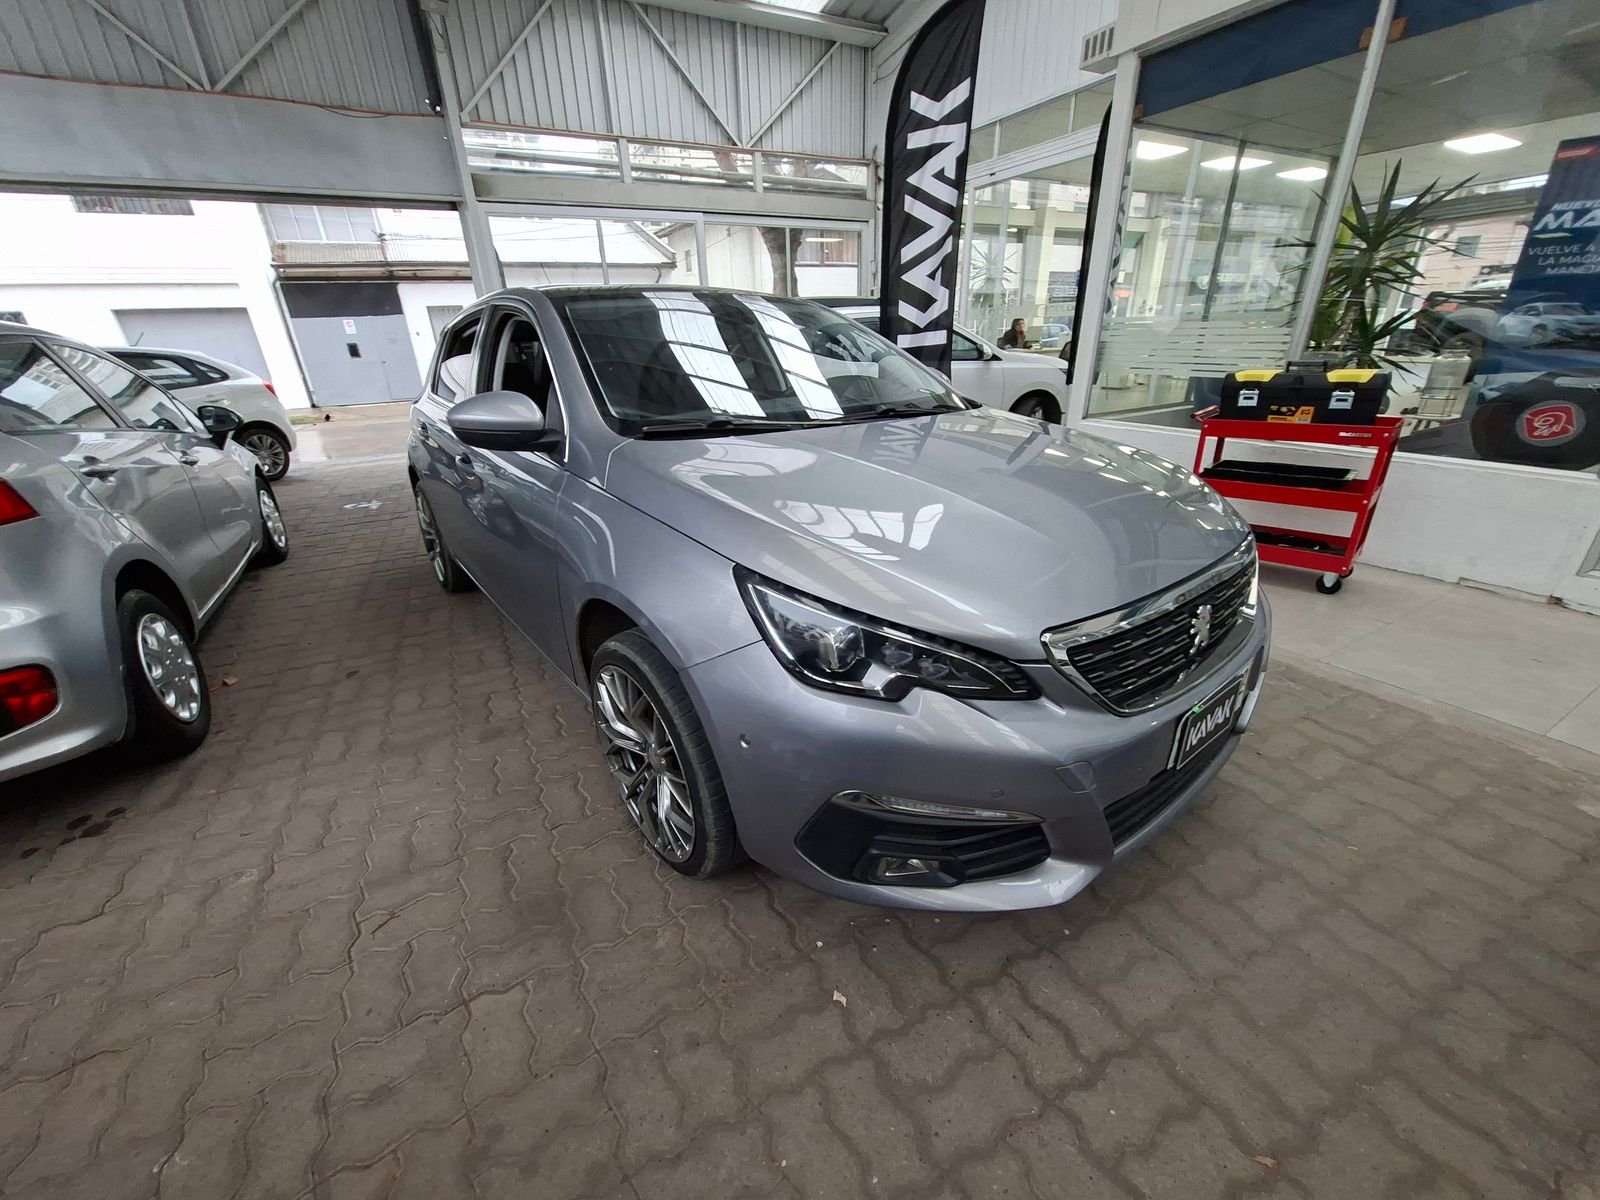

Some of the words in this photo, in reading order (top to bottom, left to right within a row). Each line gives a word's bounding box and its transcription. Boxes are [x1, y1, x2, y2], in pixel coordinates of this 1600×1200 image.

[897, 76, 971, 348] KAVAK
[1528, 244, 1582, 255] VUELVE
[1584, 244, 1595, 252] A
[1538, 256, 1554, 266] LA
[1185, 695, 1235, 751] KAVAK
